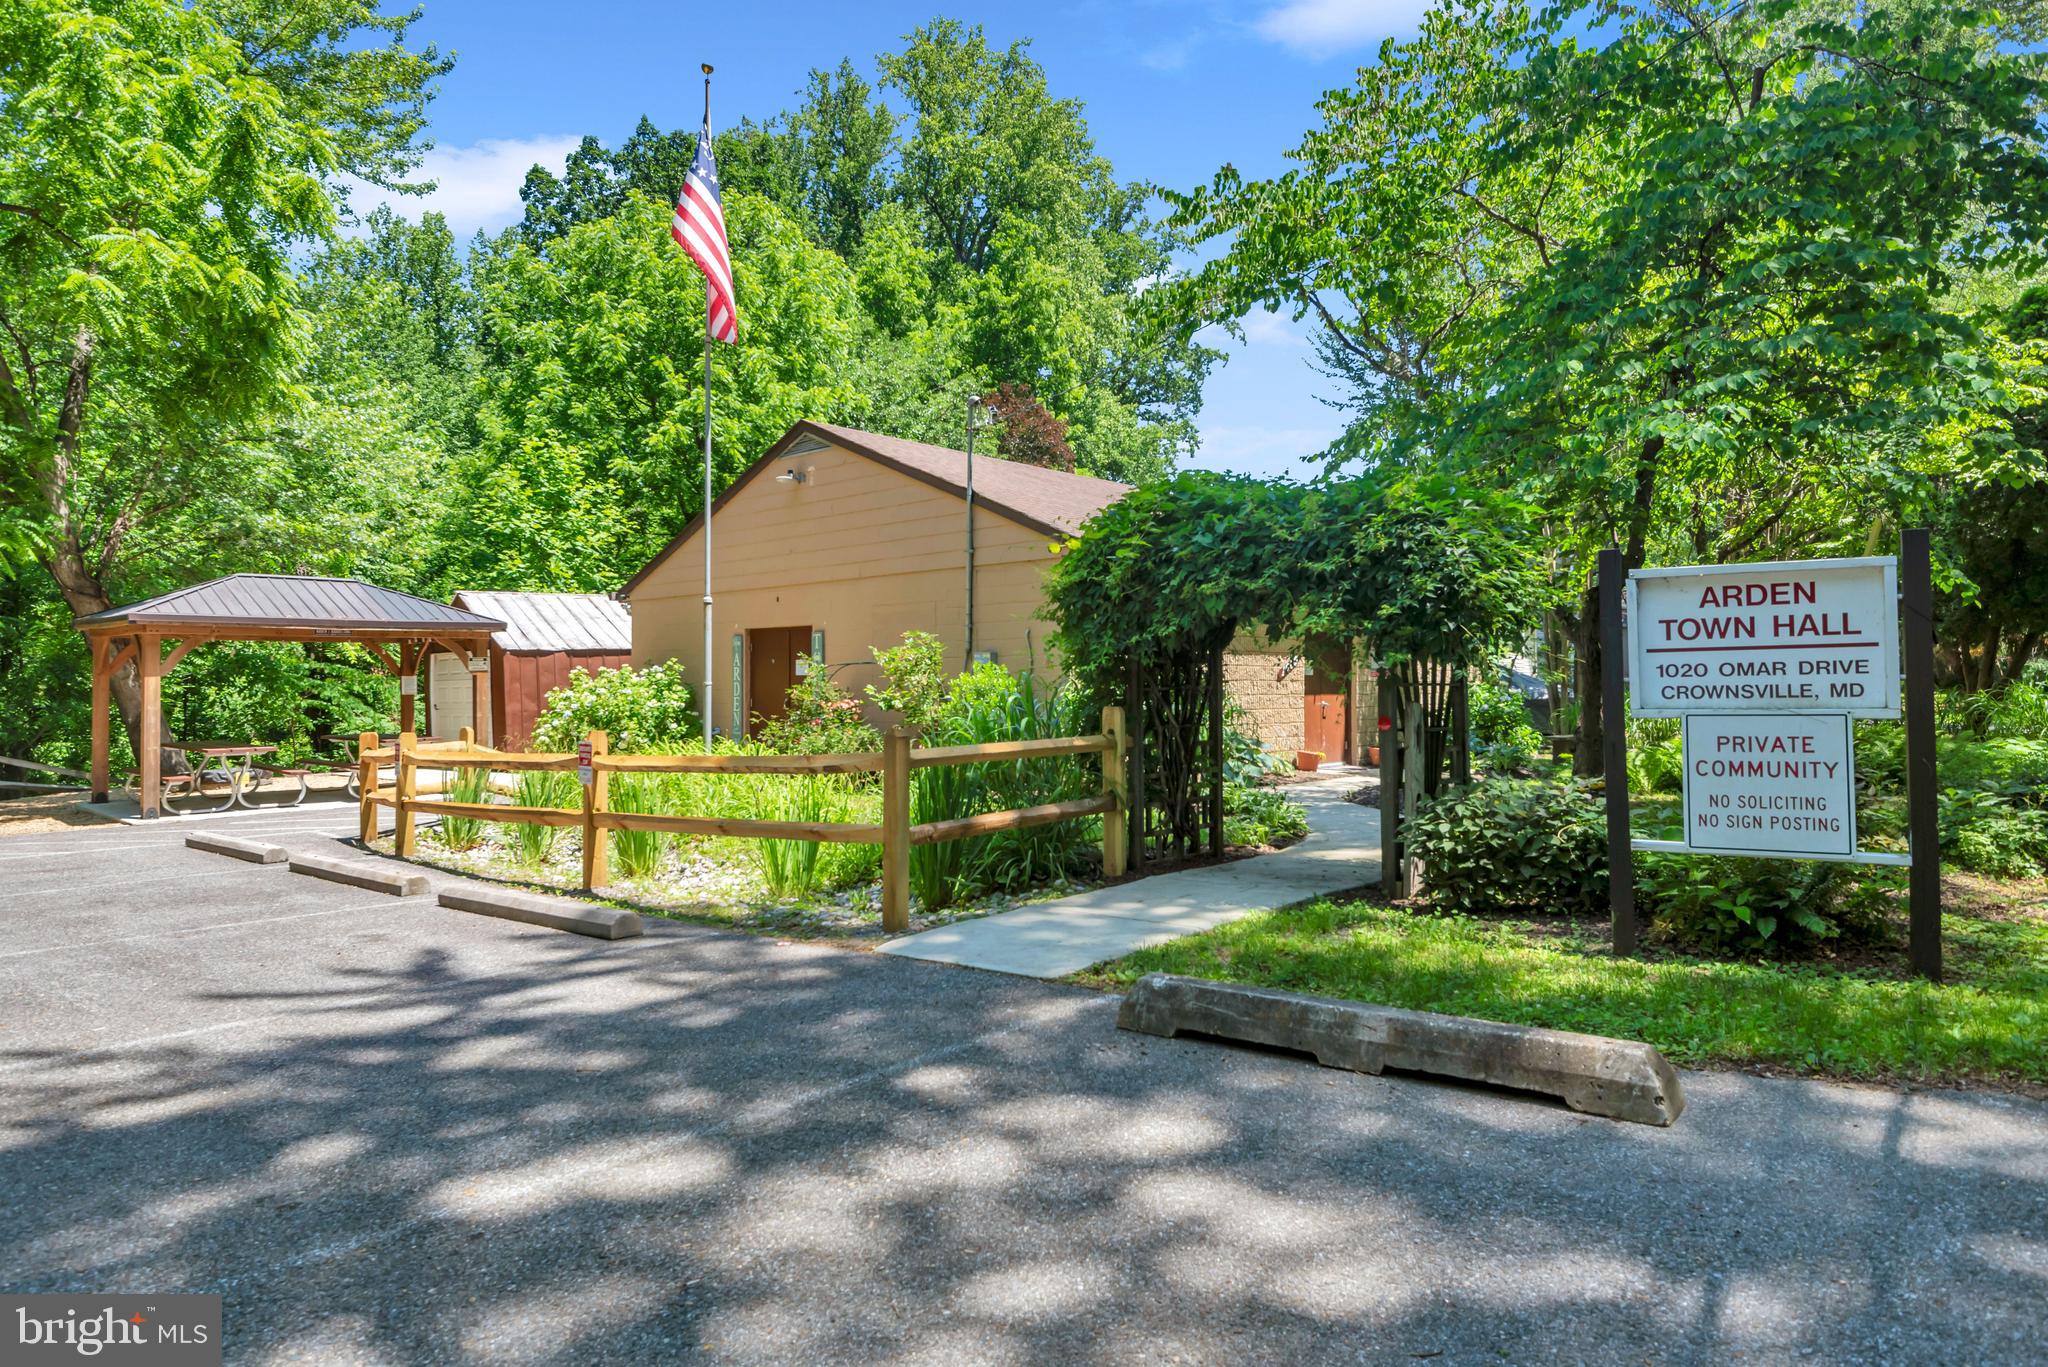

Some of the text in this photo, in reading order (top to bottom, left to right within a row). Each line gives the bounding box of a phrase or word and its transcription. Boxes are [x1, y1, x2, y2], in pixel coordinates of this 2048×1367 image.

[1699, 582, 1816, 608] ARDEN
[1659, 613, 1862, 641] TOWN HALL
[1656, 659, 1870, 678] 1020 OMAR DRIVE
[733, 652, 741, 726] ARDEN
[1661, 682, 1865, 700] CROWNSVILLE, MD
[1716, 735, 1816, 753] PRIVATE
[1695, 760, 1840, 779] COMMUNITY
[1709, 794, 1828, 811] NO SOLICITING
[1698, 814, 1841, 832] NO SIGN POSTING
